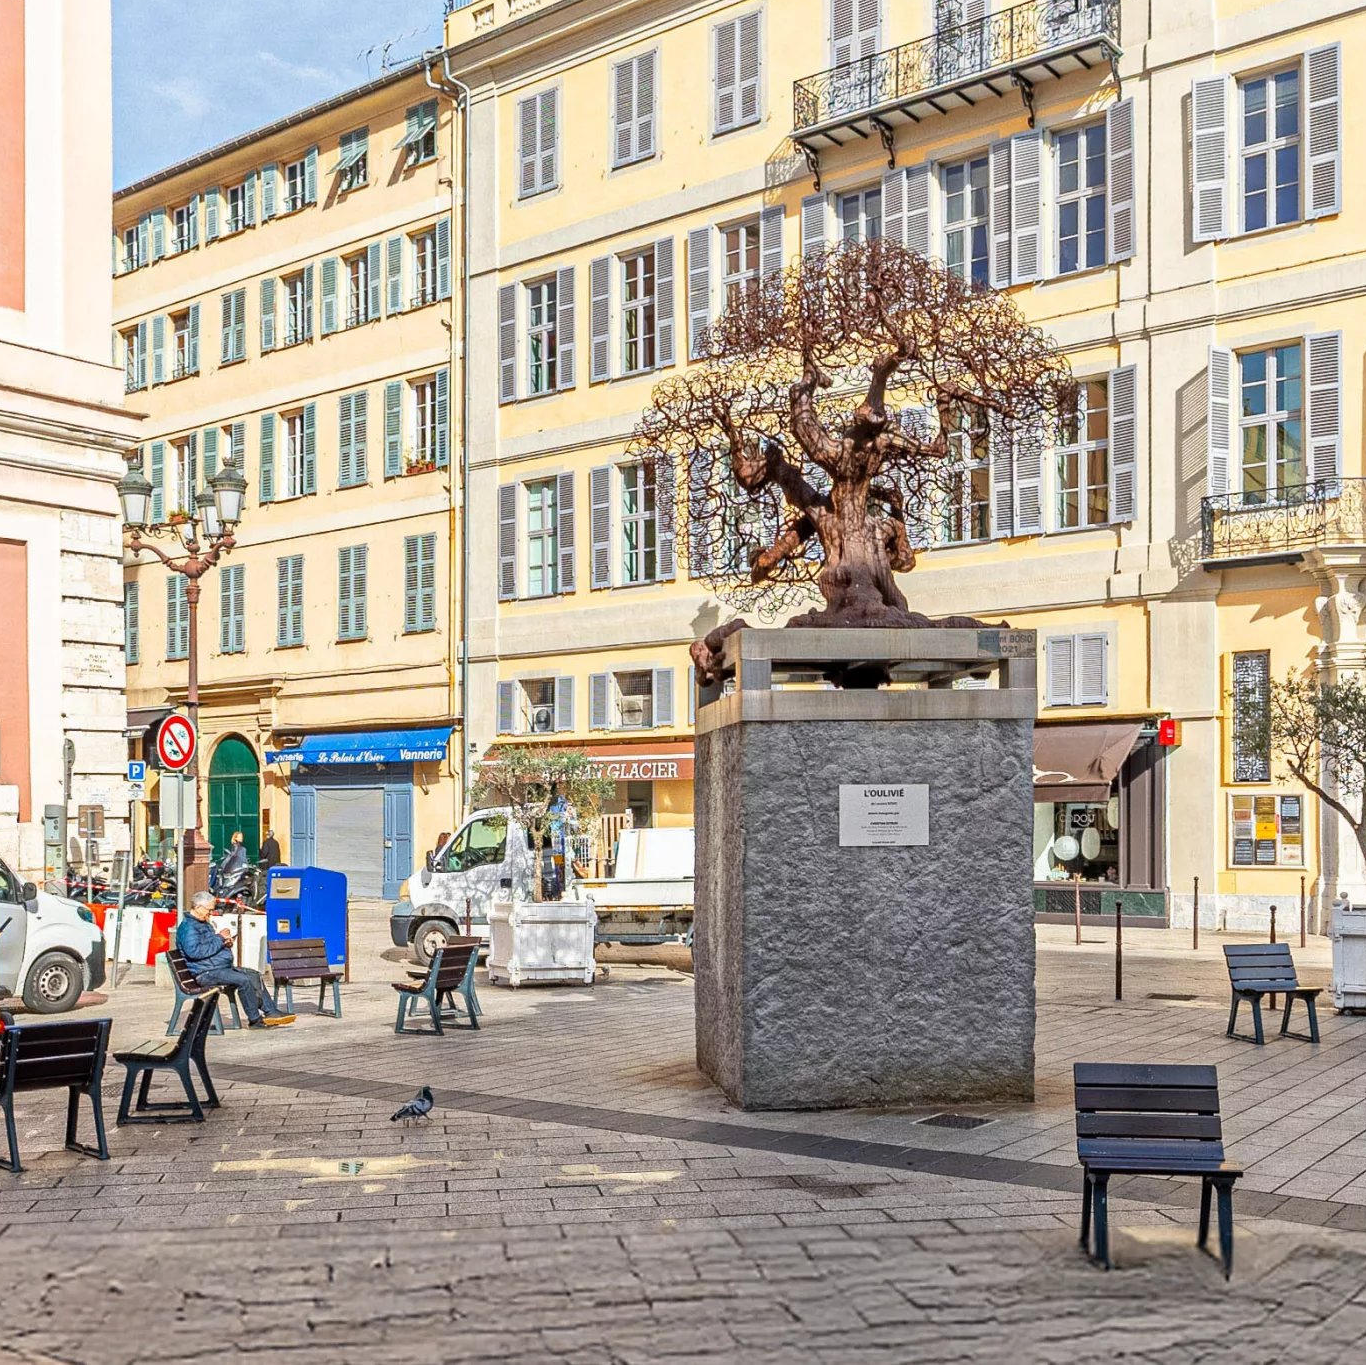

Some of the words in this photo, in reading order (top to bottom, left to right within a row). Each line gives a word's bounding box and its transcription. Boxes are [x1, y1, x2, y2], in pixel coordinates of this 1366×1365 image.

[317, 753, 329, 763] Le
[329, 752, 355, 763] Palais
[399, 747, 443, 761] Vannerie
[132, 765, 141, 778] P
[606, 761, 679, 780] GLACIER
[864, 788, 905, 798] L'OULIVIÉ
